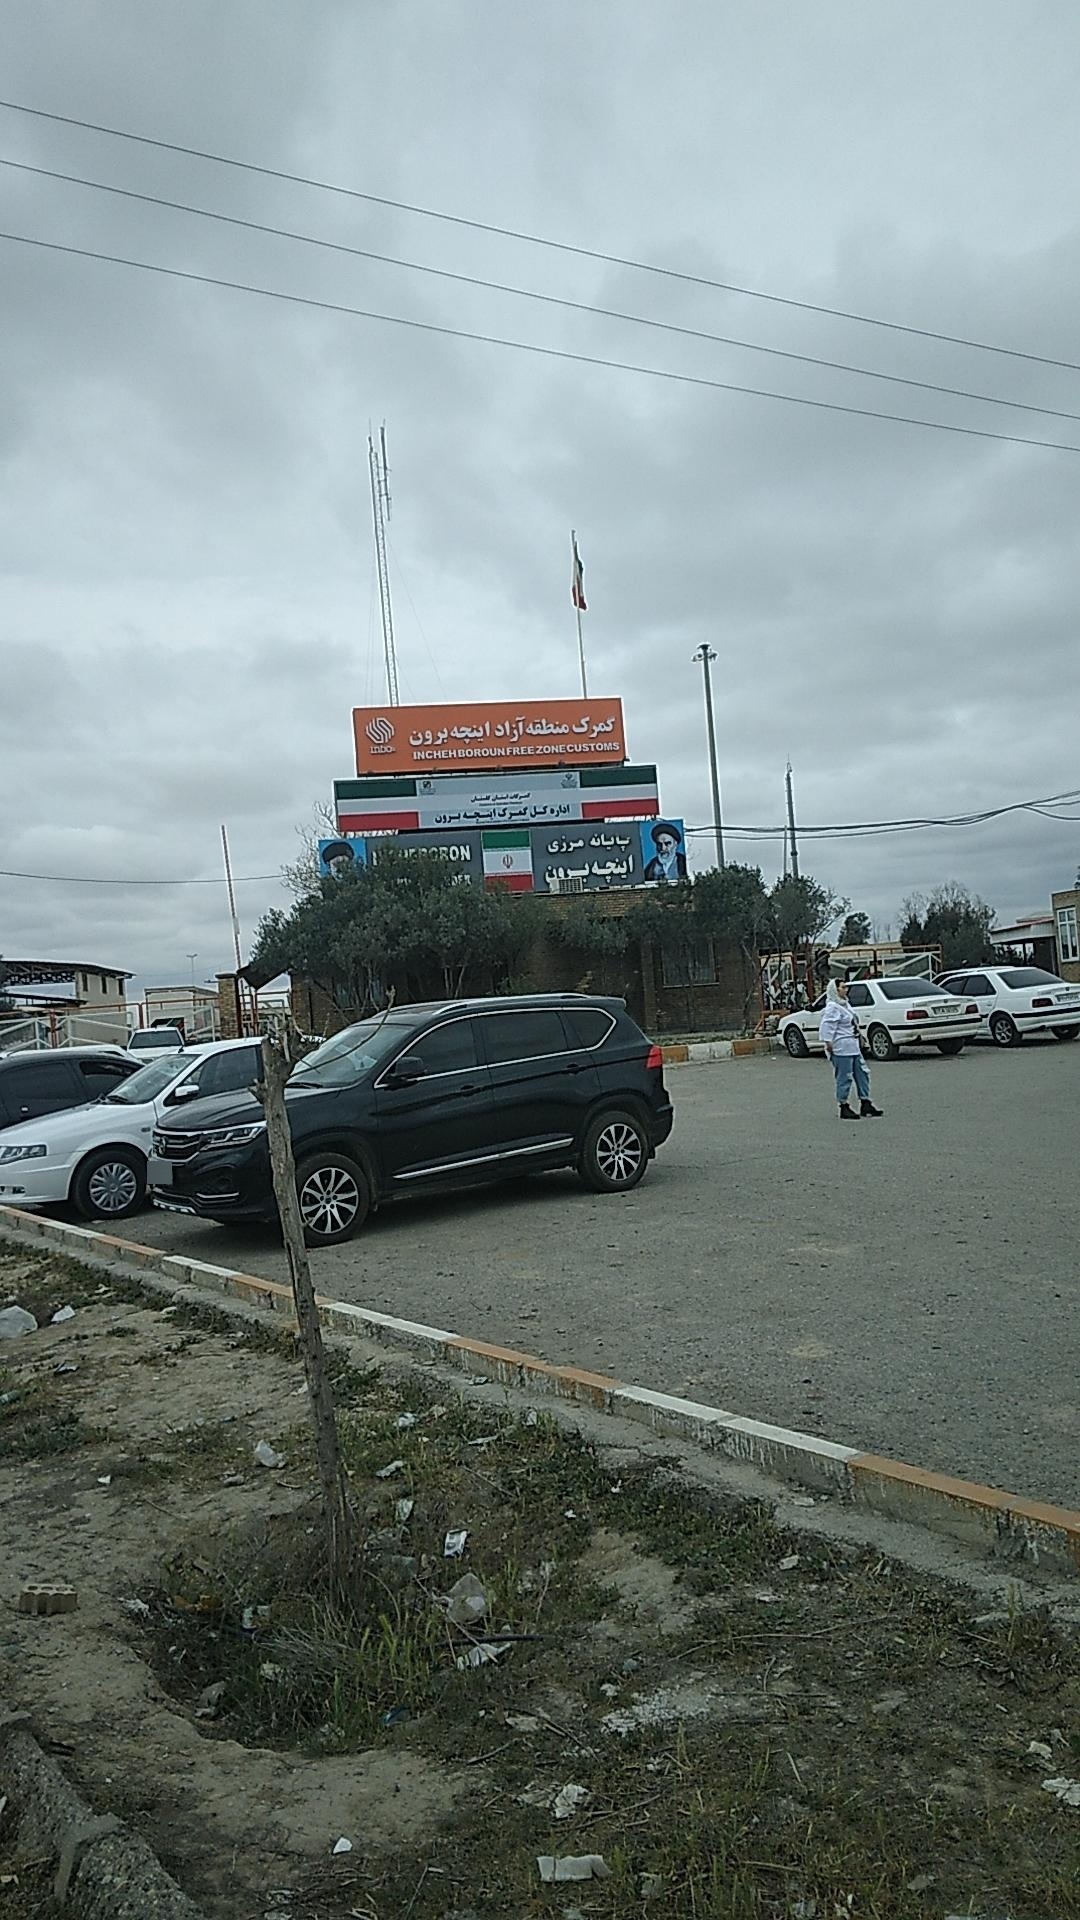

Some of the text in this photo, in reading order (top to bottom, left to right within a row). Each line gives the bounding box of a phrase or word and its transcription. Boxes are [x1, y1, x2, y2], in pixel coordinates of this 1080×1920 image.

[409, 726, 449, 746] برون
[450, 720, 492, 744] اینچه
[494, 716, 526, 742] آزاد
[525, 718, 570, 736] منطقه
[413, 741, 620, 760] INCHEH BOROUN FREE ZONE CUSTOMS
[434, 812, 461, 823] برون
[462, 808, 497, 822] اینچه
[530, 805, 548, 818] کل
[550, 803, 570, 817] اداره
[548, 833, 631, 853] پایانه مرزی
[591, 854, 635, 883] اینچه
